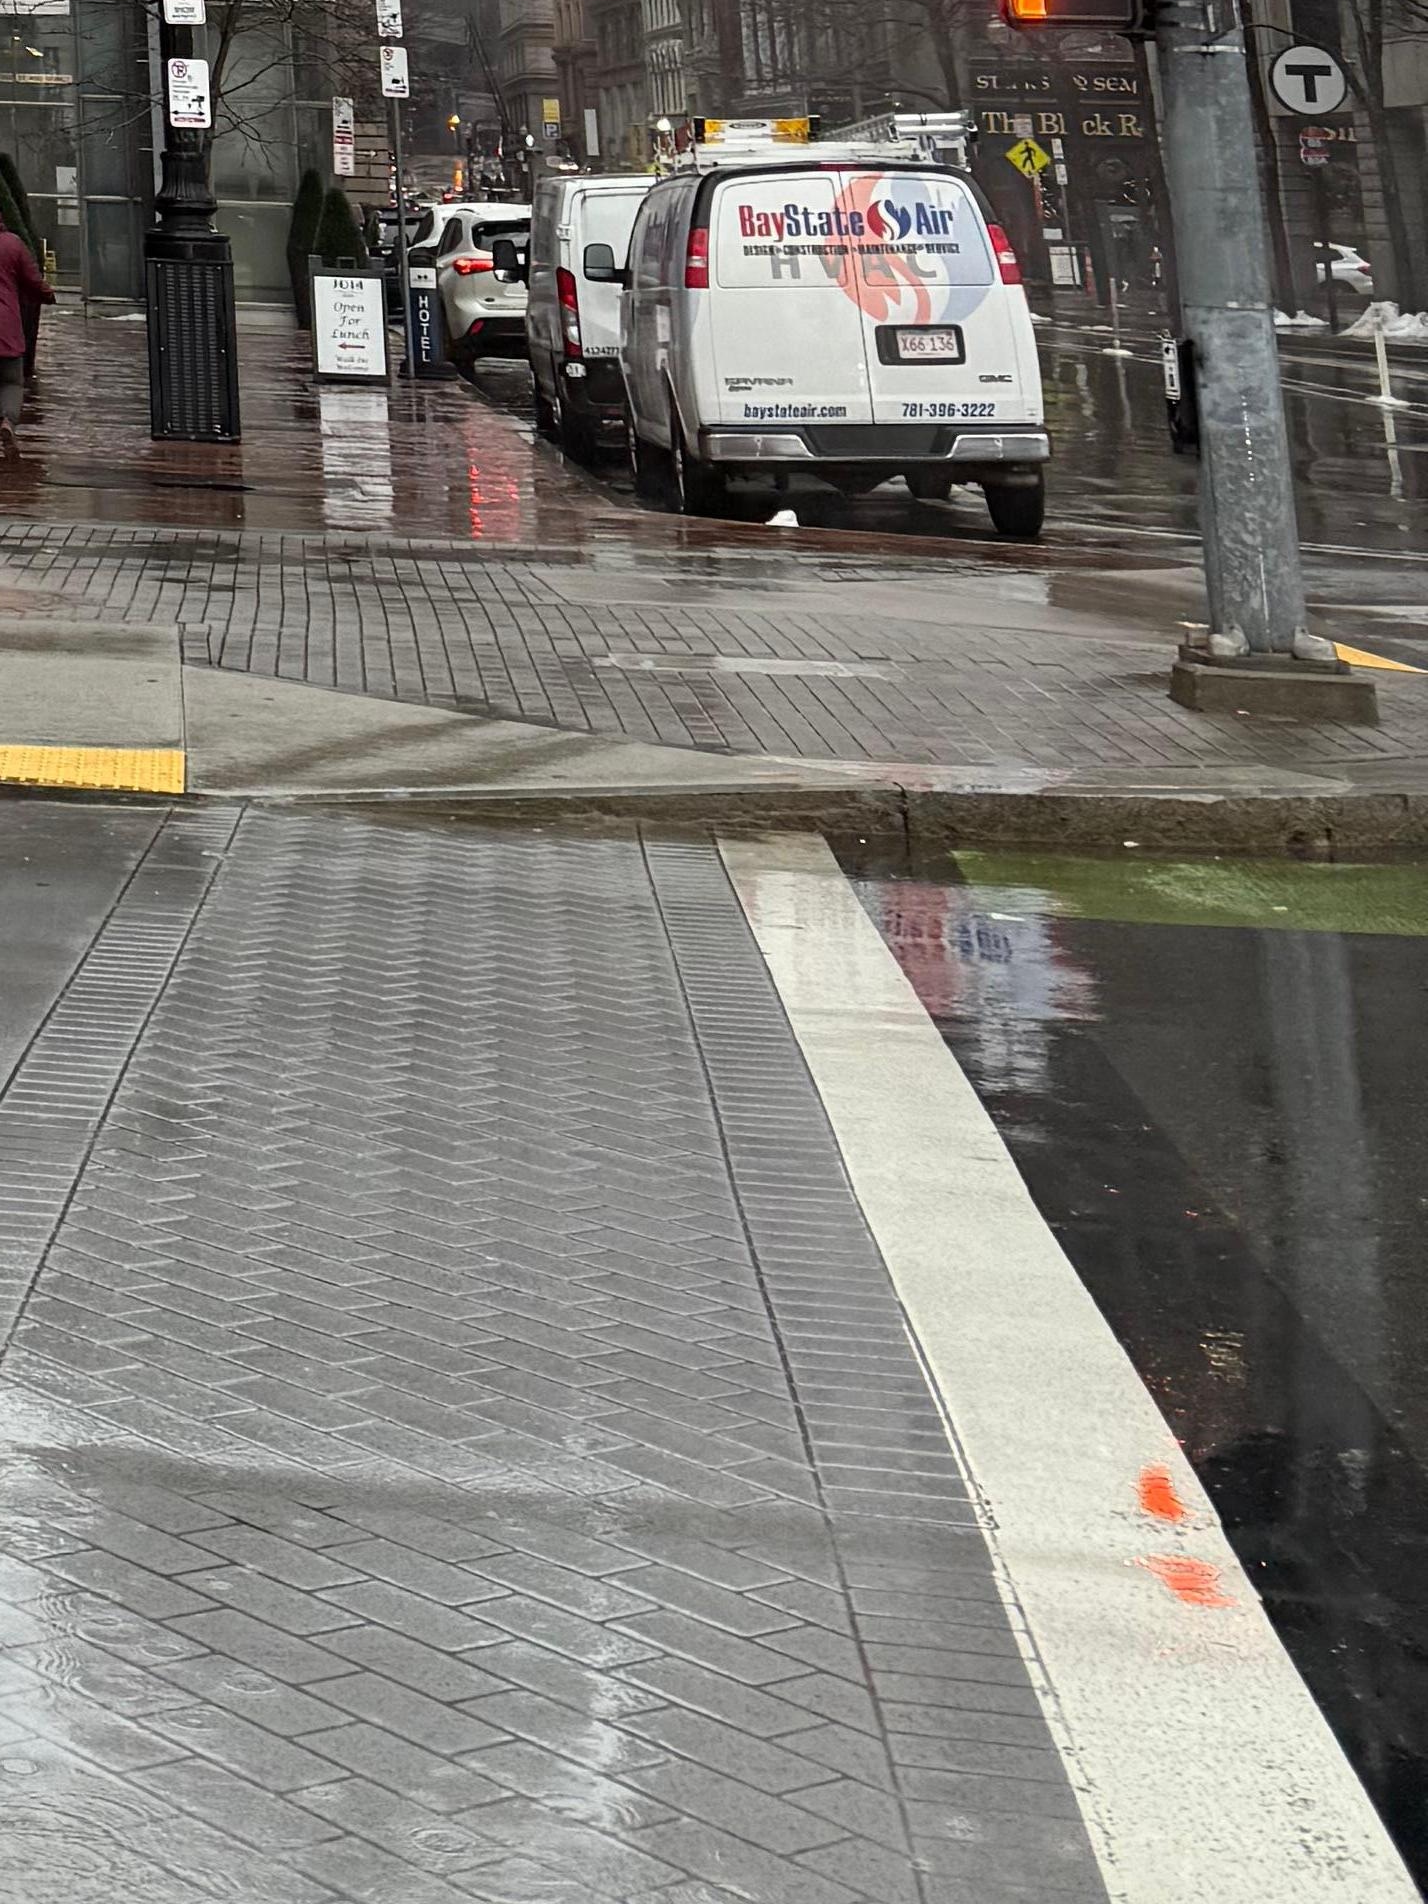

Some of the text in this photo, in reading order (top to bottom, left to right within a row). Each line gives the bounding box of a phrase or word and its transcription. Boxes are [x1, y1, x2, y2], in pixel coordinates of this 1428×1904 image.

[1285, 64, 1332, 103] T
[1038, 112, 1114, 137] Blck
[738, 202, 953, 242] BayState Air
[333, 302, 364, 314] Open
[331, 329, 370, 340] Lunch
[418, 295, 431, 362] HOTEL
[743, 403, 996, 420] baystateair.com 781-396-3222
